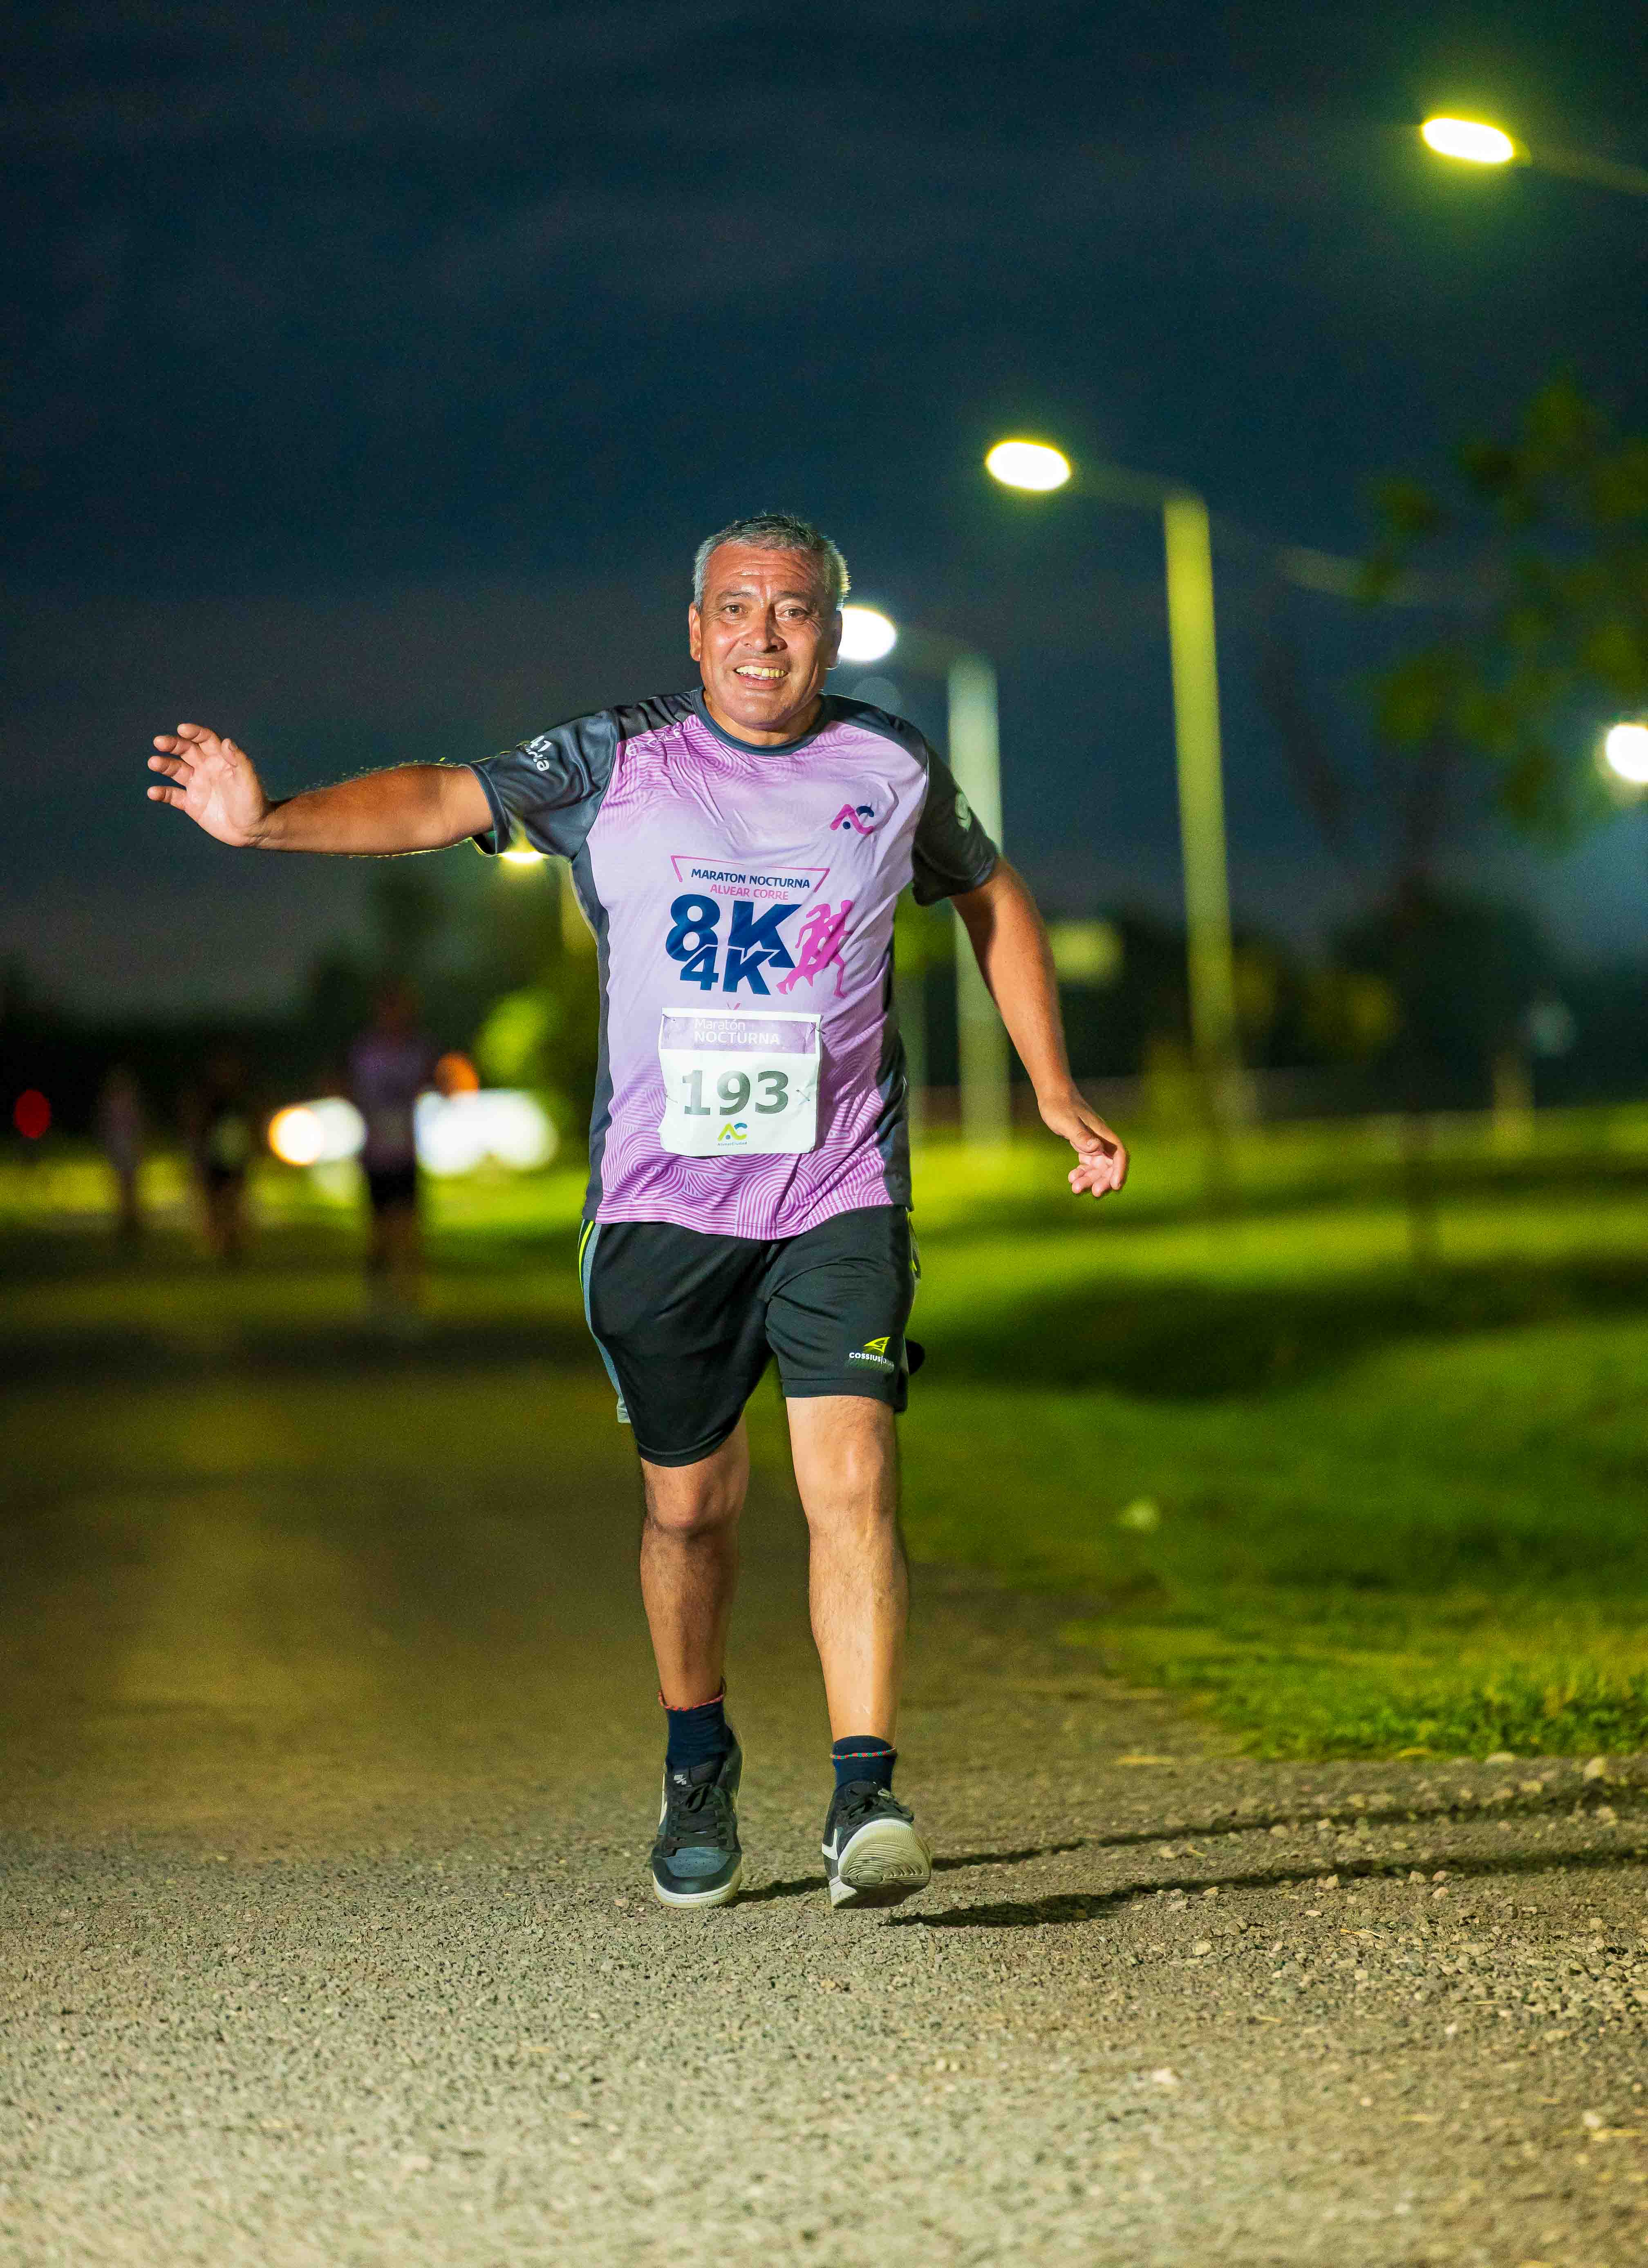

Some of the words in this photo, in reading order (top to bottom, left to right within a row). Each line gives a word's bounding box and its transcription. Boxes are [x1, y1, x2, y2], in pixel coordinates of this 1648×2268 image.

[691, 868, 746, 884] MARATON
[749, 875, 810, 888] NOCTURNA
[709, 884, 750, 897] ALVEAR
[753, 889, 788, 900] CORRE
[665, 894, 803, 968] 8K
[680, 945, 771, 995] 4K
[694, 1018, 746, 1031] Maratón
[694, 1031, 780, 1045] NOCTURNA
[682, 1069, 789, 1116] 193
